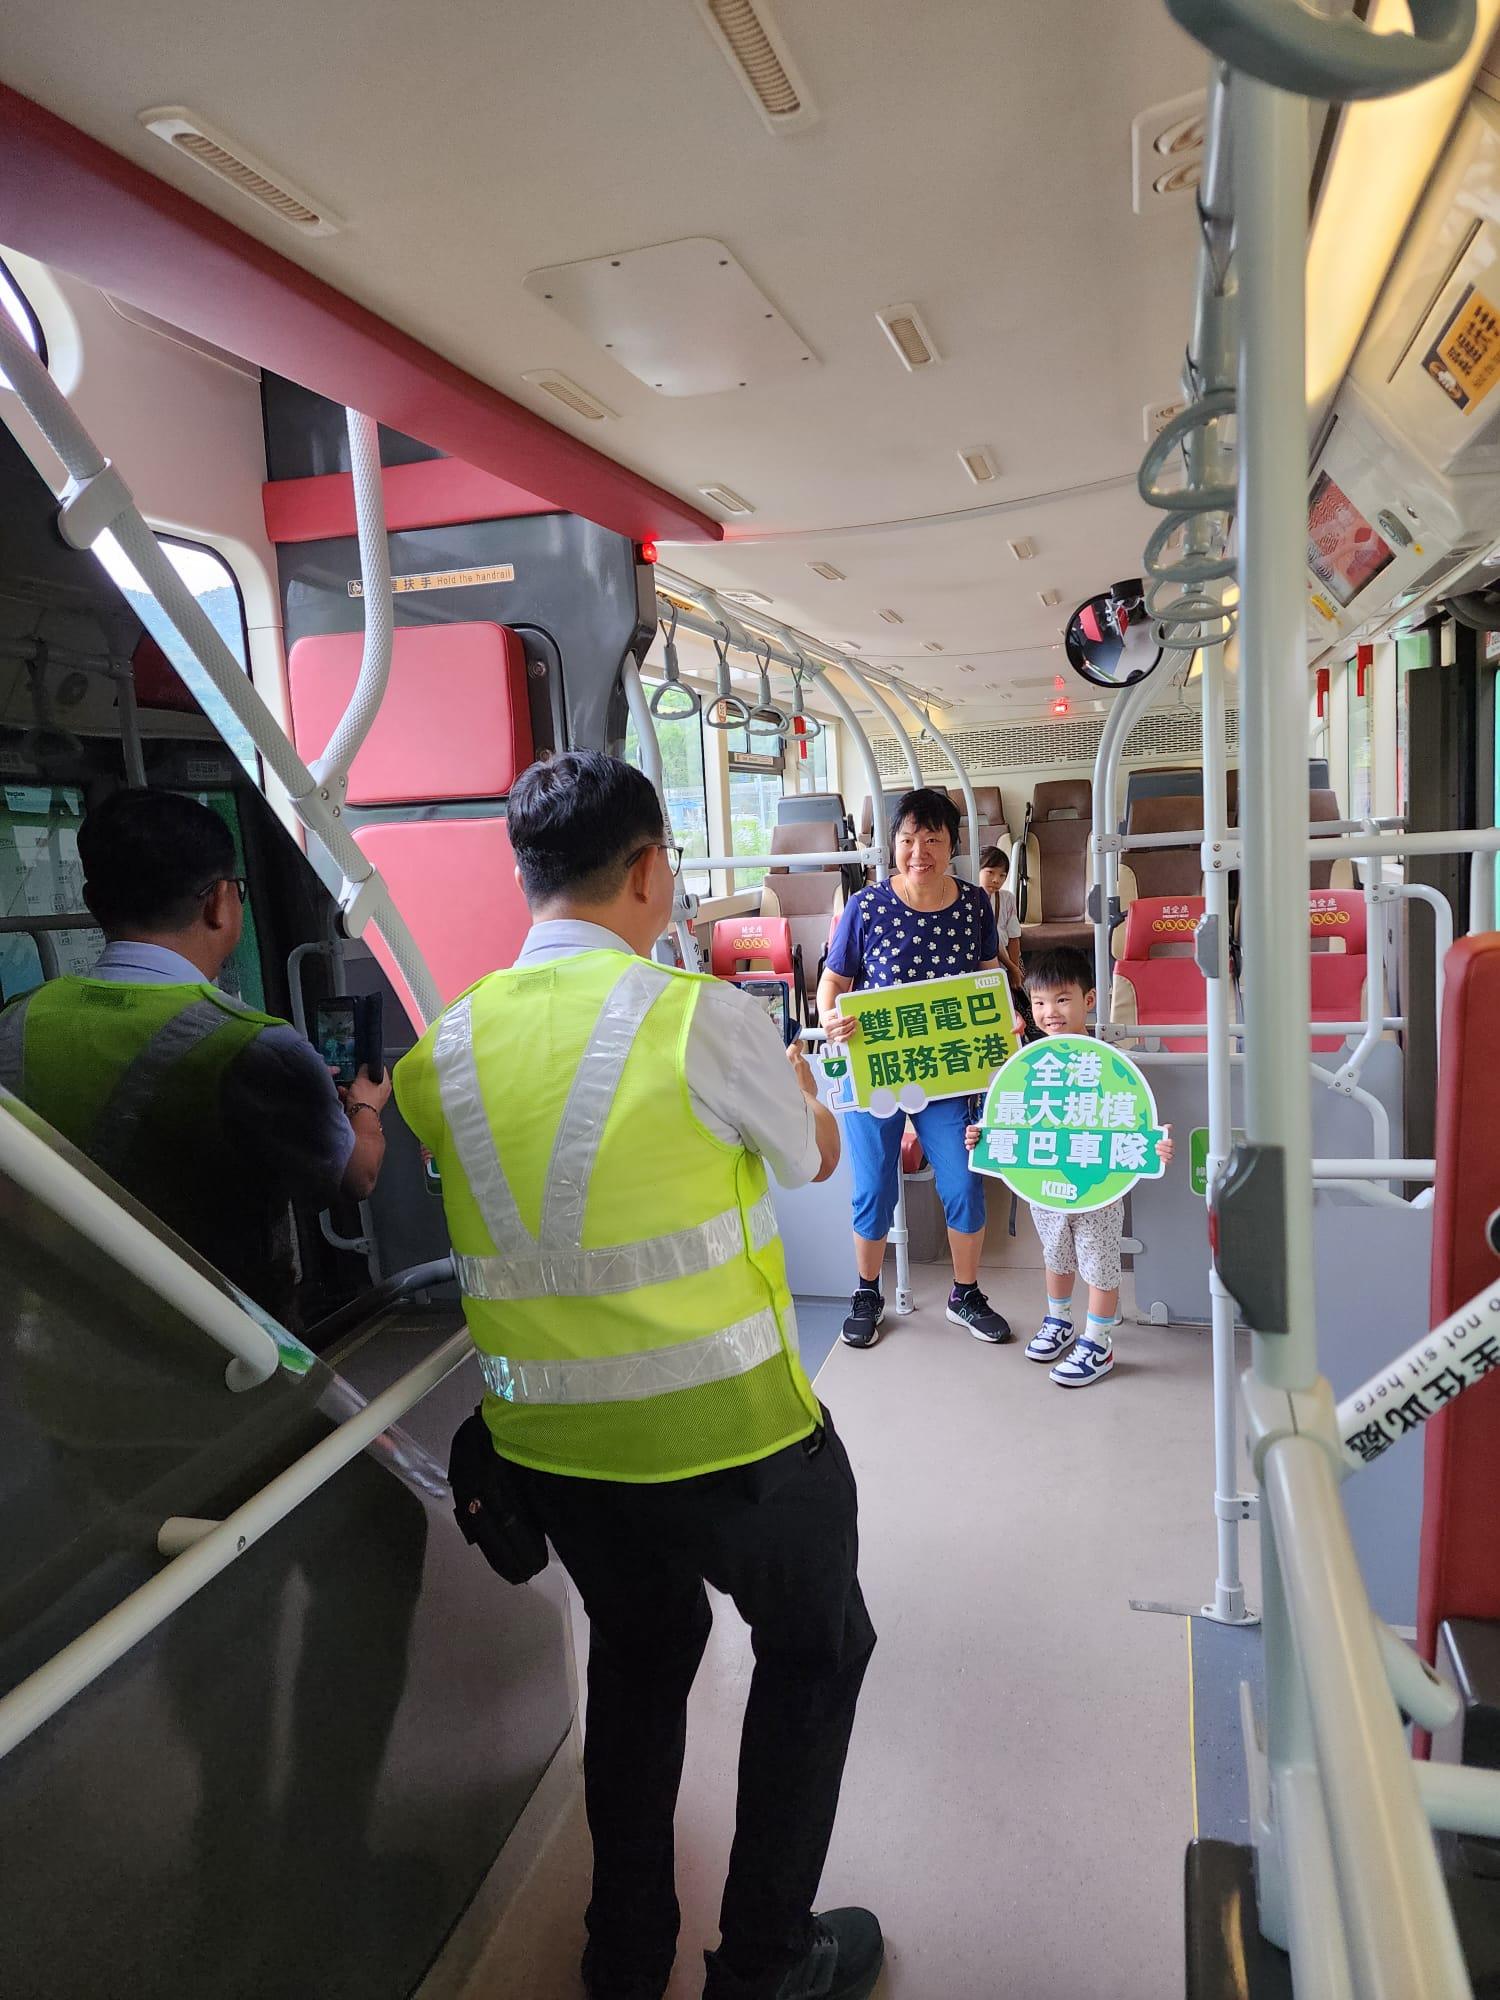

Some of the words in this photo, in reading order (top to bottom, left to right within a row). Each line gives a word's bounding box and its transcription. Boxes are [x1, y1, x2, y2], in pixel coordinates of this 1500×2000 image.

[437, 575, 456, 585] Hold
[459, 573, 473, 583] the
[476, 567, 511, 581] handrail
[858, 992, 1001, 1045] 雙層電巴
[867, 1033, 1009, 1087] 服務香港
[1031, 1051, 1102, 1088] 全港
[993, 1090, 1138, 1128] 最大規模
[986, 1129, 1149, 1170] 電巴車隊
[1443, 1313, 1482, 1350] not
[1407, 1346, 1438, 1376] sit
[1354, 1372, 1406, 1414] here
